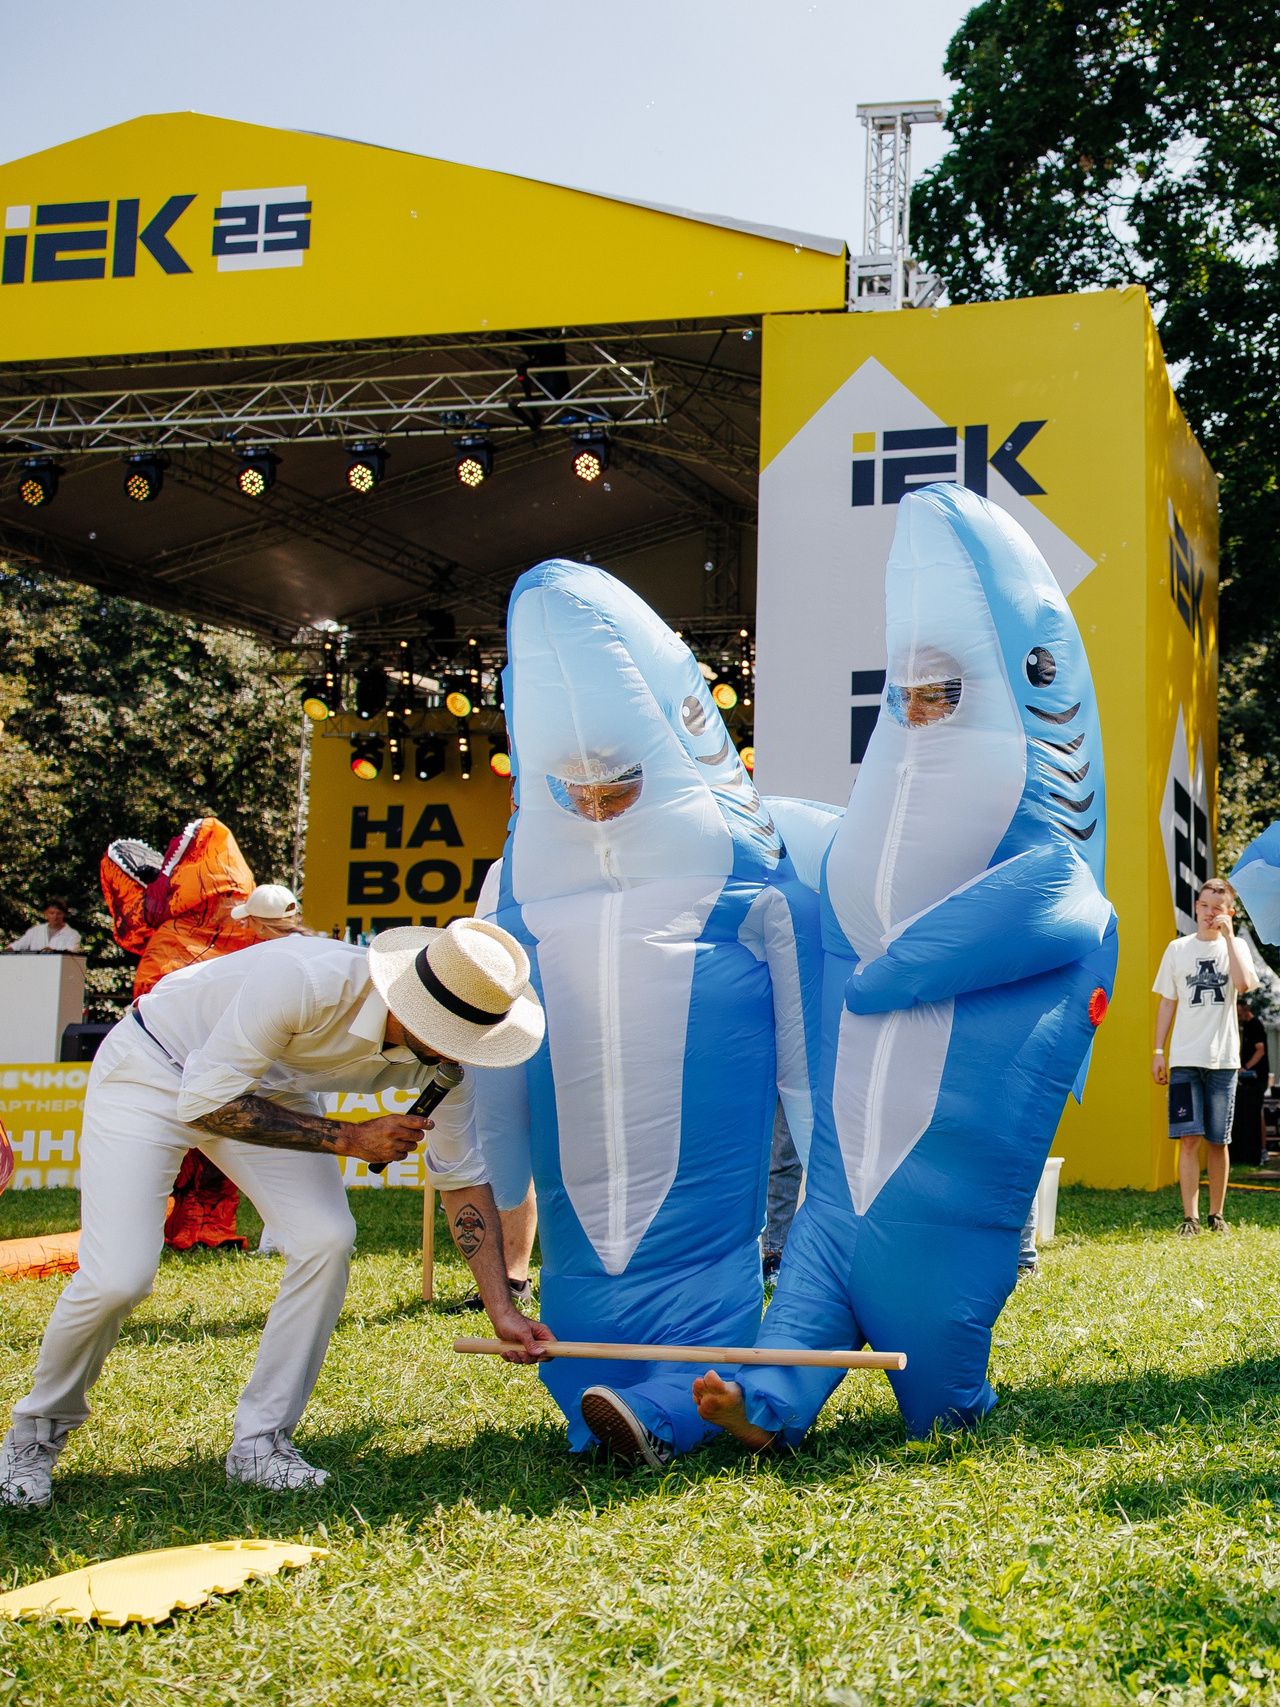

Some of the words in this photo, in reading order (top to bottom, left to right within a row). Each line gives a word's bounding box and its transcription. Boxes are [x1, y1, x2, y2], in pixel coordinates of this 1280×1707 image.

[212, 201, 312, 257] 25
[350, 804, 464, 849] НА
[342, 1153, 425, 1188] ДЕ
